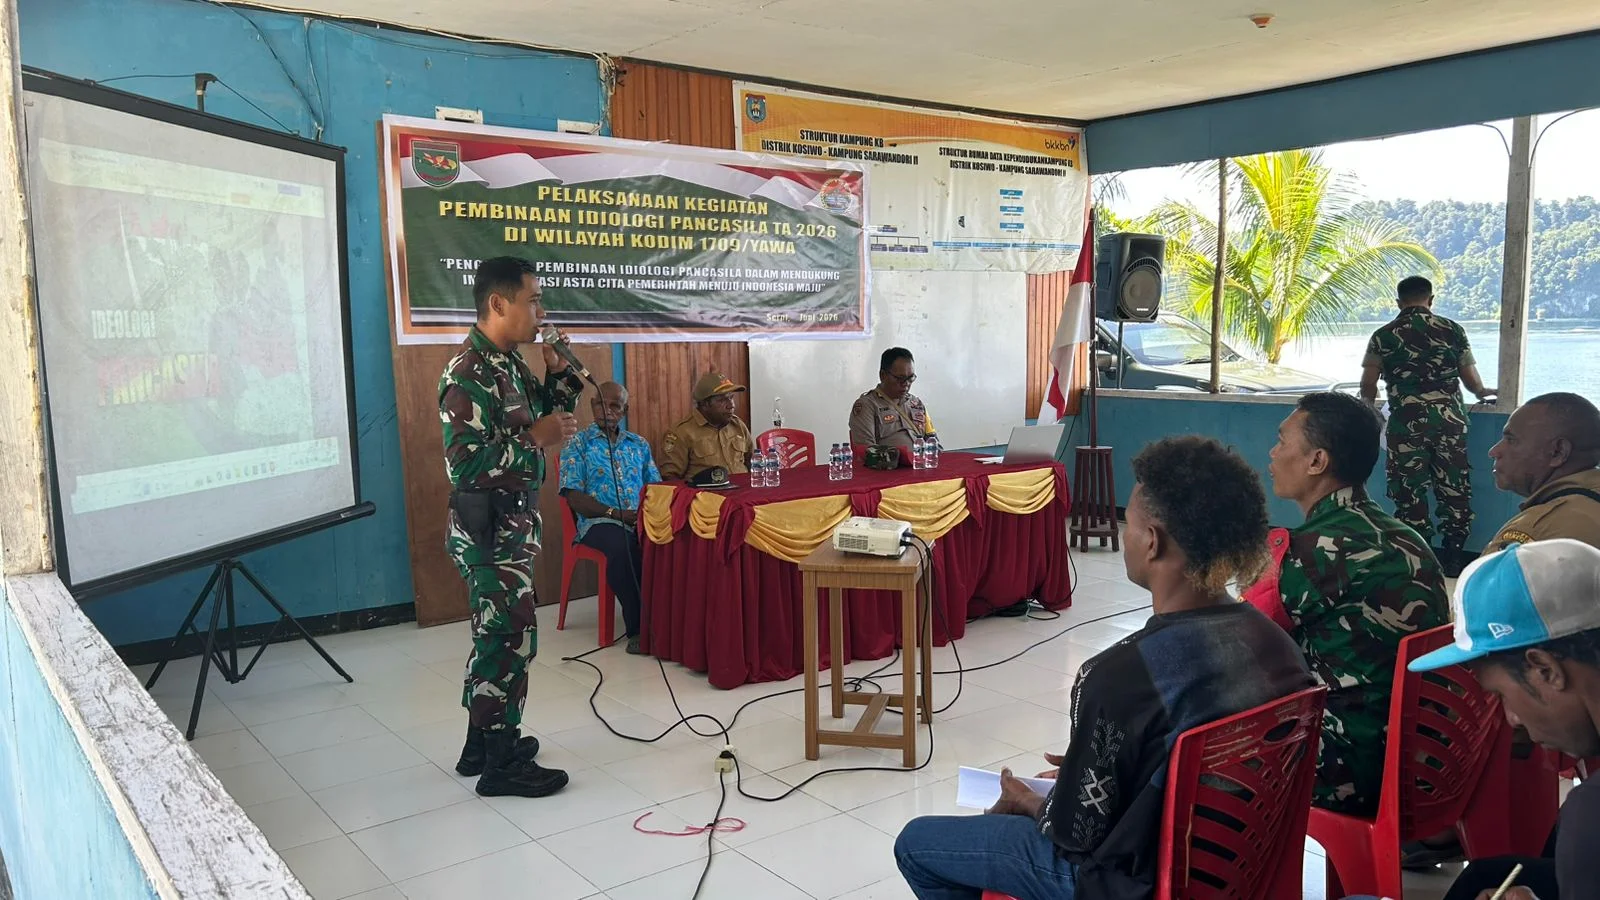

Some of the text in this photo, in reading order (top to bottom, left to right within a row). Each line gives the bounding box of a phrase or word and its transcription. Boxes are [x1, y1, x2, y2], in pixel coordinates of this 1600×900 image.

[800, 129, 884, 148] STRUKTUR KAMPUNG KB
[1044, 138, 1070, 150] bkkbn
[761, 139, 791, 153] DISTRIK
[792, 142, 822, 156] KOSIWO
[828, 148, 863, 160] KAMPUNG
[864, 150, 912, 165] SARAWANDORI
[939, 147, 968, 158] STRUKTUR
[990, 152, 1002, 160] DATA
[950, 160, 972, 170] DISTRIK
[972, 162, 994, 172] KOSIWO
[999, 164, 1024, 174] KAMPUNG
[538, 185, 768, 215] PELAKSANAAN KEGIATAN
[439, 200, 837, 238] PEMBINAAN IDIOLOGI PANCASILA TA 2026
[504, 226, 796, 254] DI WILAYAH KODIM 1709/YAWA
[536, 261, 616, 274] PEMBINAAN
[620, 264, 676, 276] IDIOLOGI
[678, 266, 742, 278] PANCASILA
[745, 268, 779, 279] DALAM
[780, 269, 840, 280] MENDUKUNG
[563, 276, 594, 288] ASTA
[597, 278, 625, 289] CITA
[627, 279, 696, 290] PEMERINTAH
[699, 280, 739, 292] MENUJU
[741, 281, 794, 292] INDONESIA
[91, 309, 156, 340] IDEOLOGI
